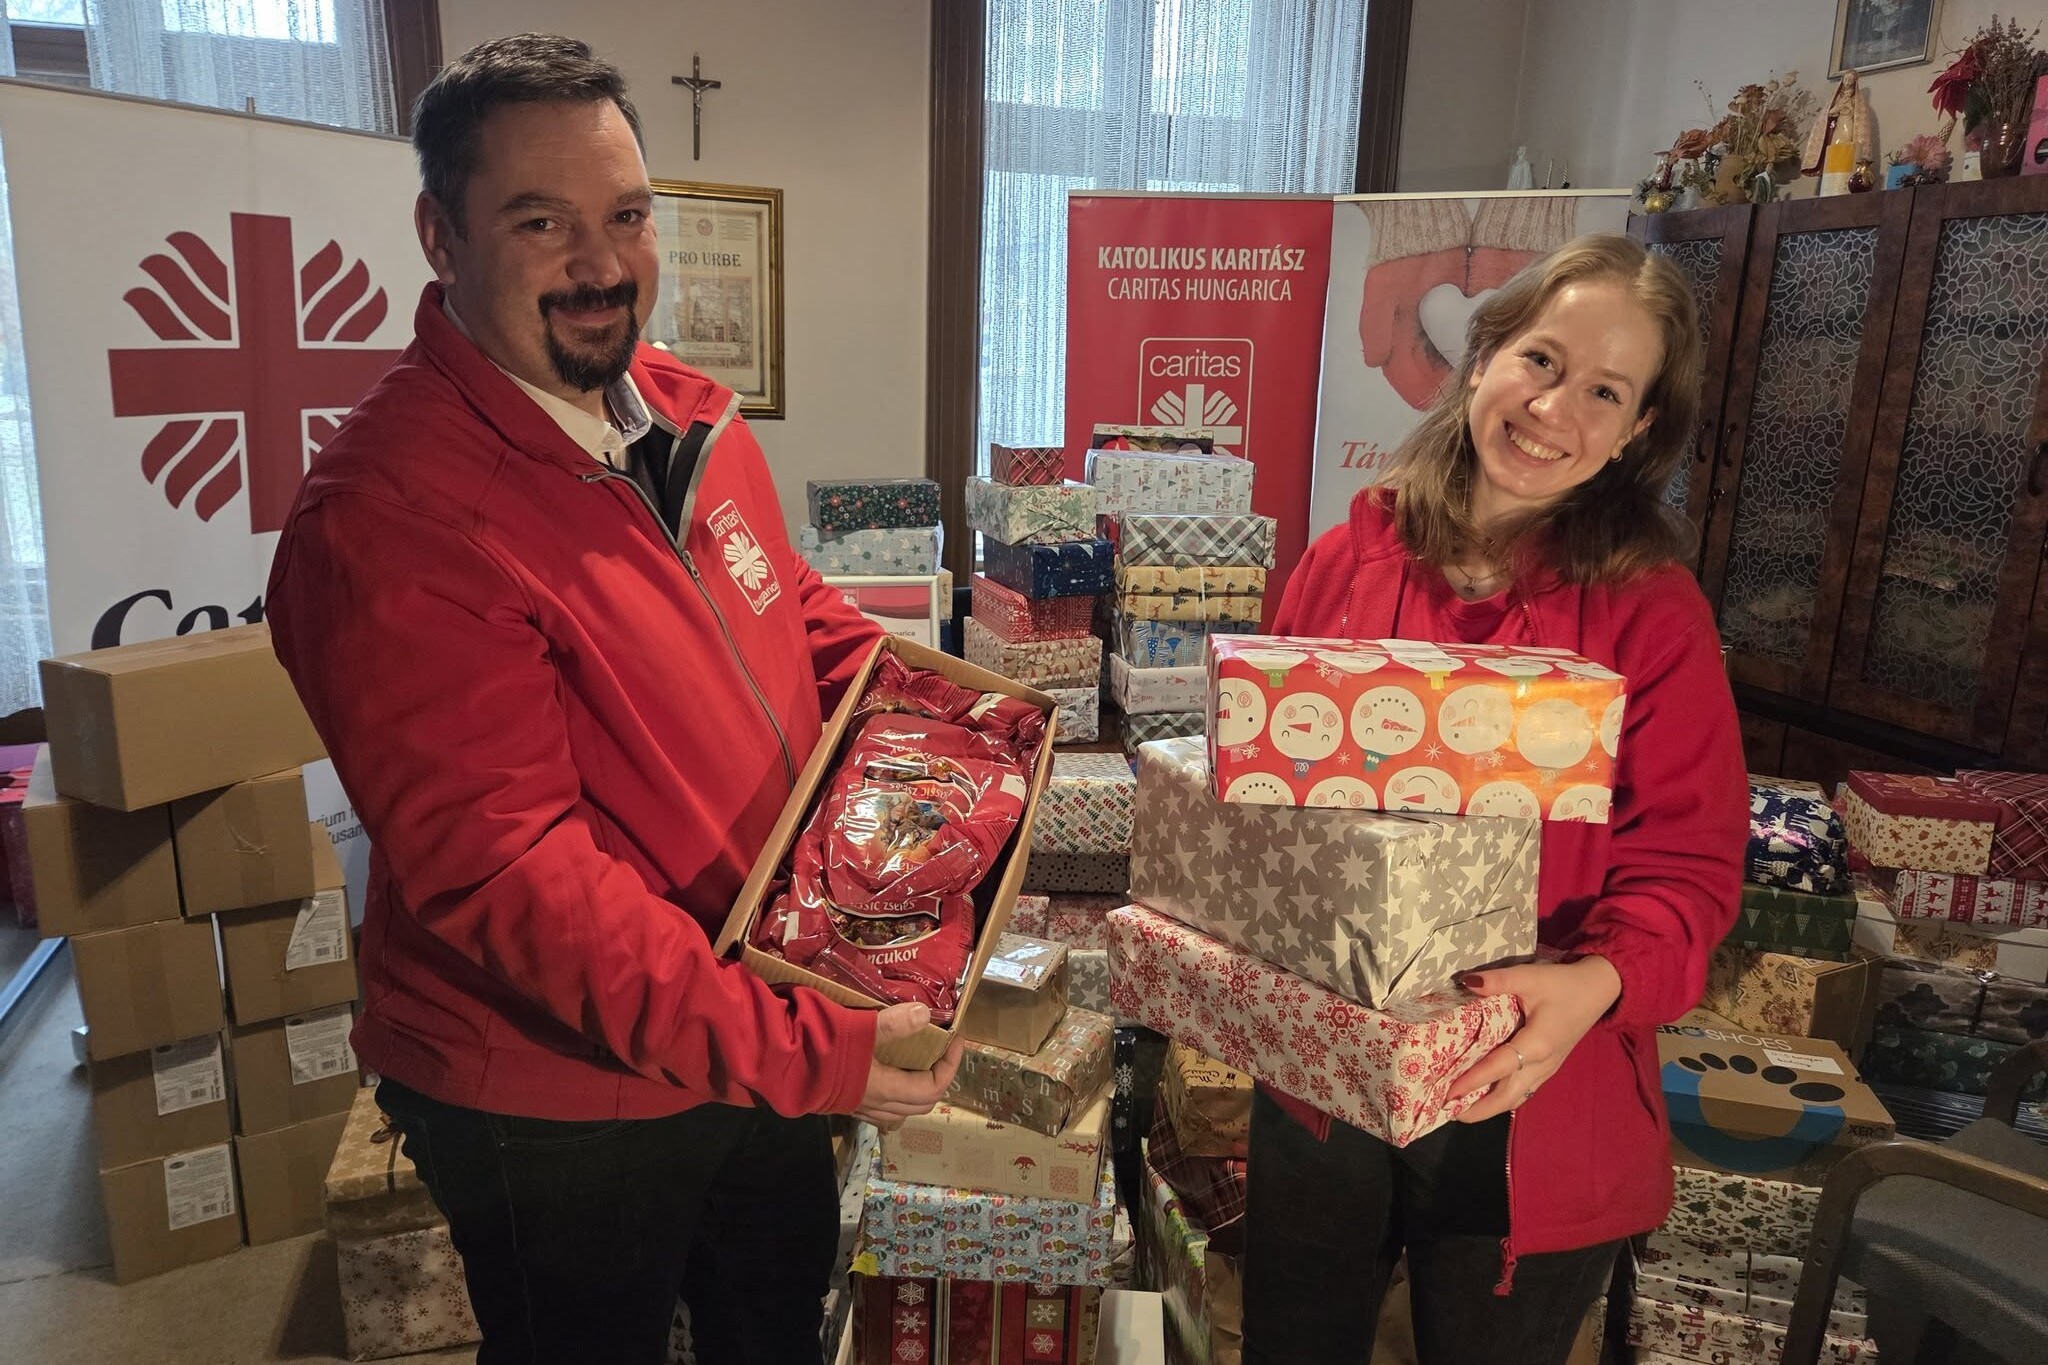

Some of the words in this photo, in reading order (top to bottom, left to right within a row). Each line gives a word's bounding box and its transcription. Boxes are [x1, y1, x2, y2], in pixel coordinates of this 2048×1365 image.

[669, 250, 697, 265] PRO
[702, 252, 741, 267] URBE
[1098, 246, 1205, 270] KATOLIKUS
[1211, 244, 1305, 271] KARITÁSZ
[1108, 277, 1181, 300] CARITAS
[1186, 278, 1291, 301] HUNGARICA
[1149, 349, 1241, 377] caritas
[1704, 1029, 1793, 1051] SHOES
